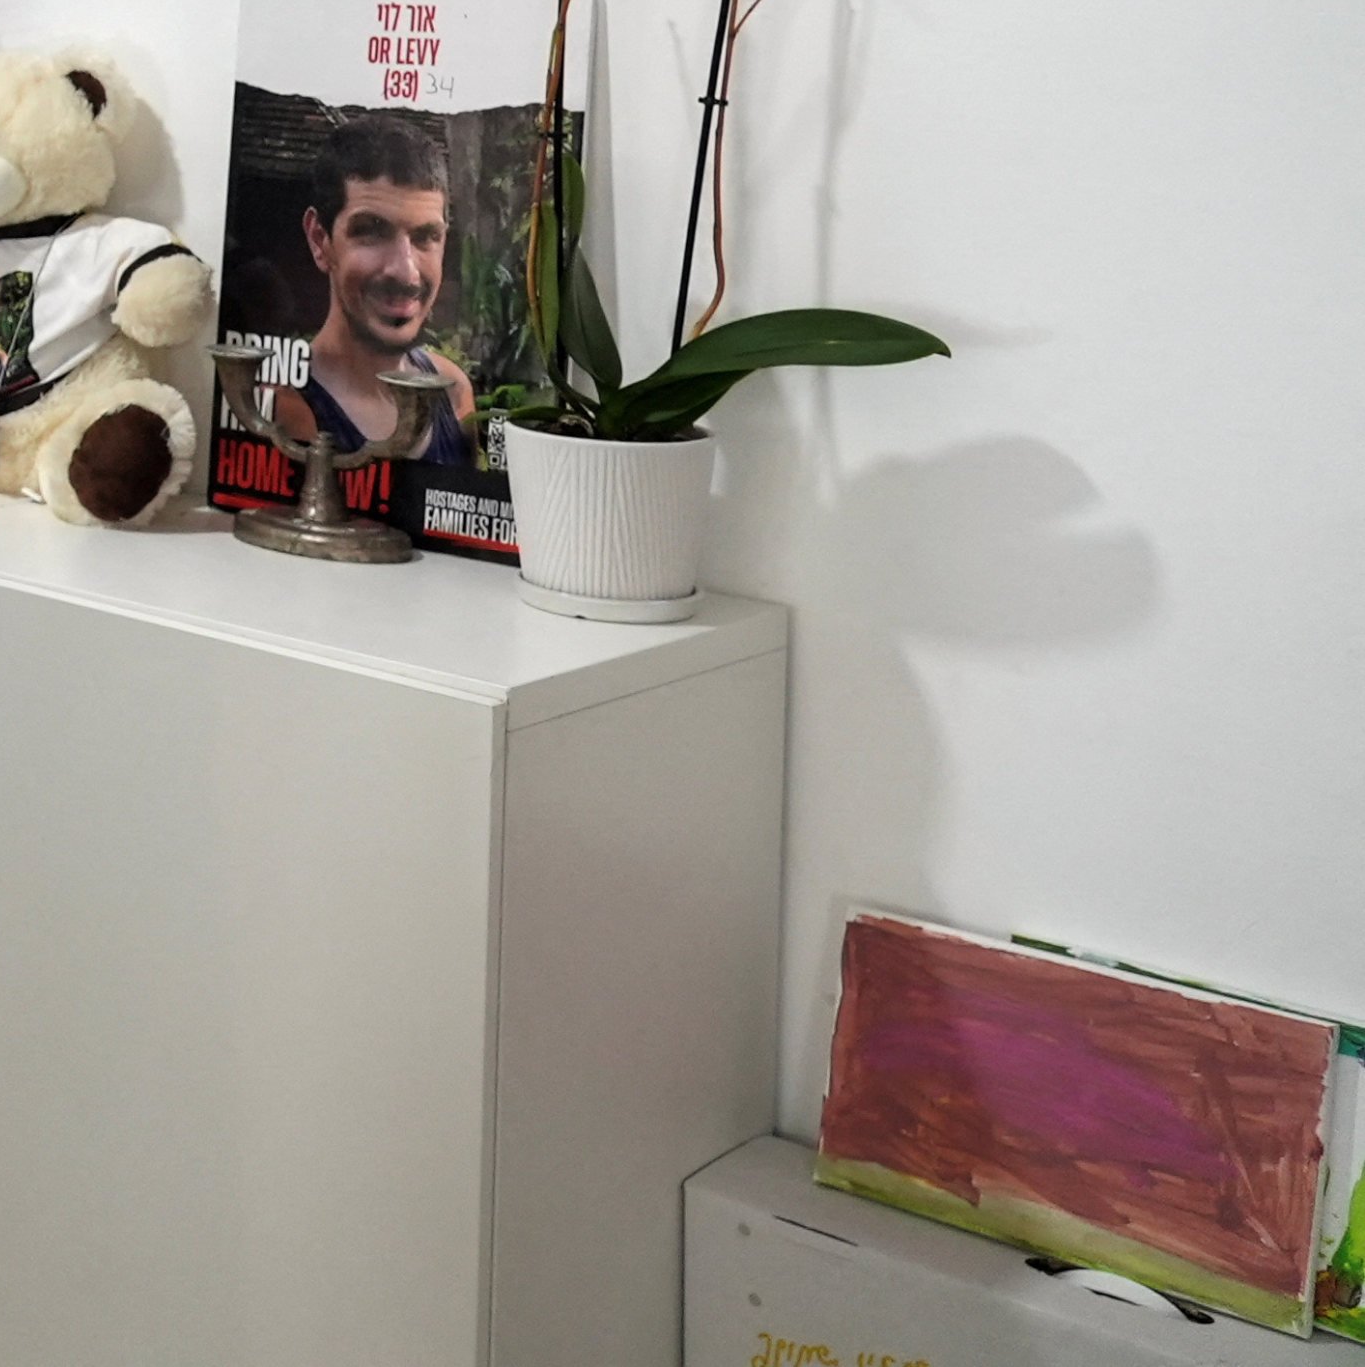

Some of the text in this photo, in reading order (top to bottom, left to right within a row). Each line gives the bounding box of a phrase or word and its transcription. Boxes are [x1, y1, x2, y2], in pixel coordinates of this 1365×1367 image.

[377, 2, 436, 32] אור לוי
[368, 36, 440, 66] OR LEVY
[383, 68, 418, 102] (33)
[425, 73, 454, 99] 34
[225, 331, 311, 389] ING
[217, 438, 295, 497] HOME
[425, 488, 477, 513] HOSTAGES
[477, 497, 499, 517] AND
[424, 505, 490, 540] FAMILIES
[491, 518, 518, 546] FOR
